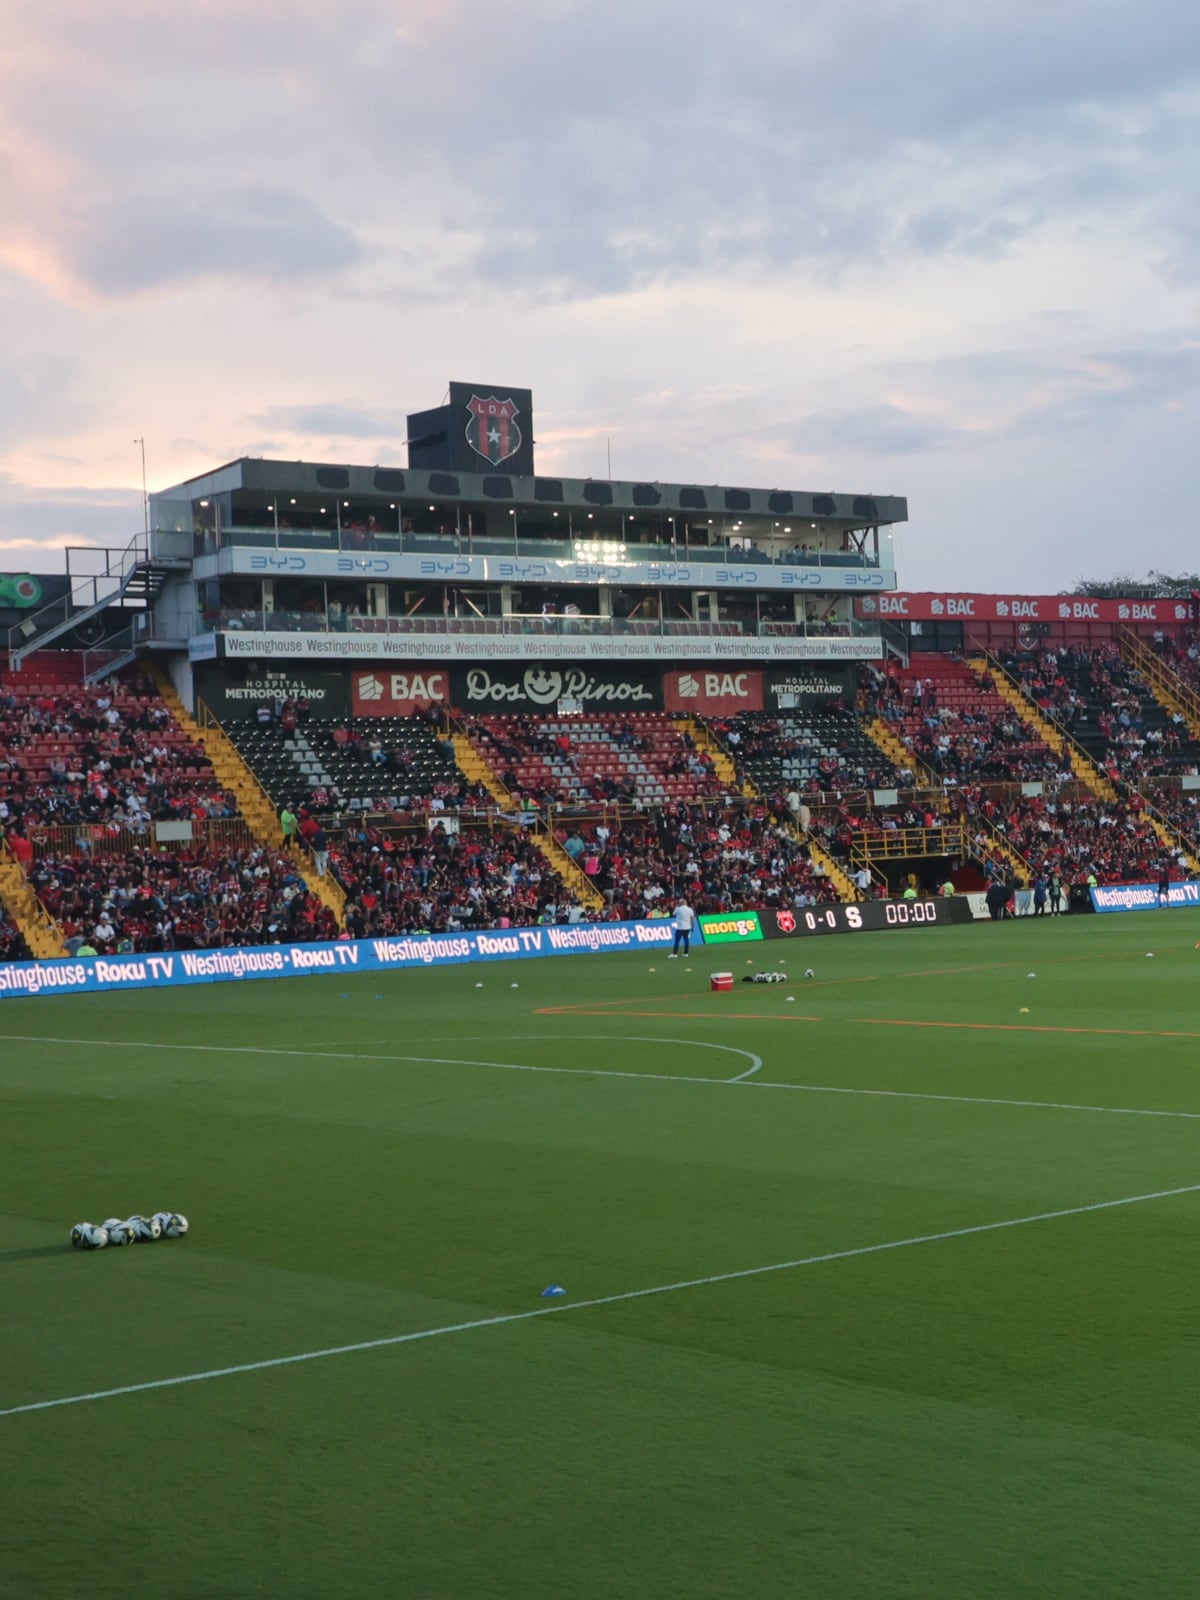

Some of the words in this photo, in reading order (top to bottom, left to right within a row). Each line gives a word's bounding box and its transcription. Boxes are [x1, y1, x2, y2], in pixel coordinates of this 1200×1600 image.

[478, 404, 509, 417] LDA
[251, 556, 306, 571] BYD
[337, 558, 390, 572] BYD
[420, 561, 471, 575] BYD
[498, 563, 547, 577] BYD
[648, 568, 691, 581] BYD
[715, 570, 758, 583] BYD
[781, 572, 822, 585] BYD
[845, 574, 884, 586] BYD
[879, 597, 908, 614] BAC
[947, 599, 975, 615] BAC
[1012, 601, 1039, 617] BAC
[1073, 602, 1099, 618] BAC
[1132, 604, 1156, 619] BAC
[228, 638, 302, 654] Westinghouse
[307, 639, 377, 655] Westinghouse
[383, 641, 450, 656] Westinghouse
[455, 642, 520, 656] Westinghouse
[524, 642, 586, 656] Westinghouse
[590, 642, 649, 656] Westinghouse
[653, 643, 711, 656] Westinghouse
[715, 642, 770, 656] Westinghouse
[773, 643, 827, 656] Westinghouse
[829, 643, 881, 657] Westinghouse
[246, 680, 307, 688] HOSPITAL
[391, 675, 445, 700] BAC
[466, 668, 526, 701] Dos
[561, 667, 653, 700] Pinos
[705, 674, 748, 697] BAC
[771, 684, 843, 694] METROPOLITANO
[785, 677, 829, 685] HOSPITAL
[225, 688, 326, 699] METROPOLITANO
[1094, 887, 1155, 908] Westinghouse
[1184, 885, 1198, 900] TV
[845, 906, 863, 928] S
[886, 902, 936, 924] 00:00
[704, 918, 755, 936] monge
[548, 925, 630, 949] Westinghouse
[637, 926, 673, 943] Roku
[373, 937, 468, 963] Westinghouse
[477, 933, 519, 954] Roku
[519, 931, 542, 951] TV
[181, 950, 284, 976] Westinghouse
[291, 948, 335, 968] Roku
[335, 945, 358, 965] TV
[95, 961, 146, 982] Roku
[147, 957, 173, 979] TV
